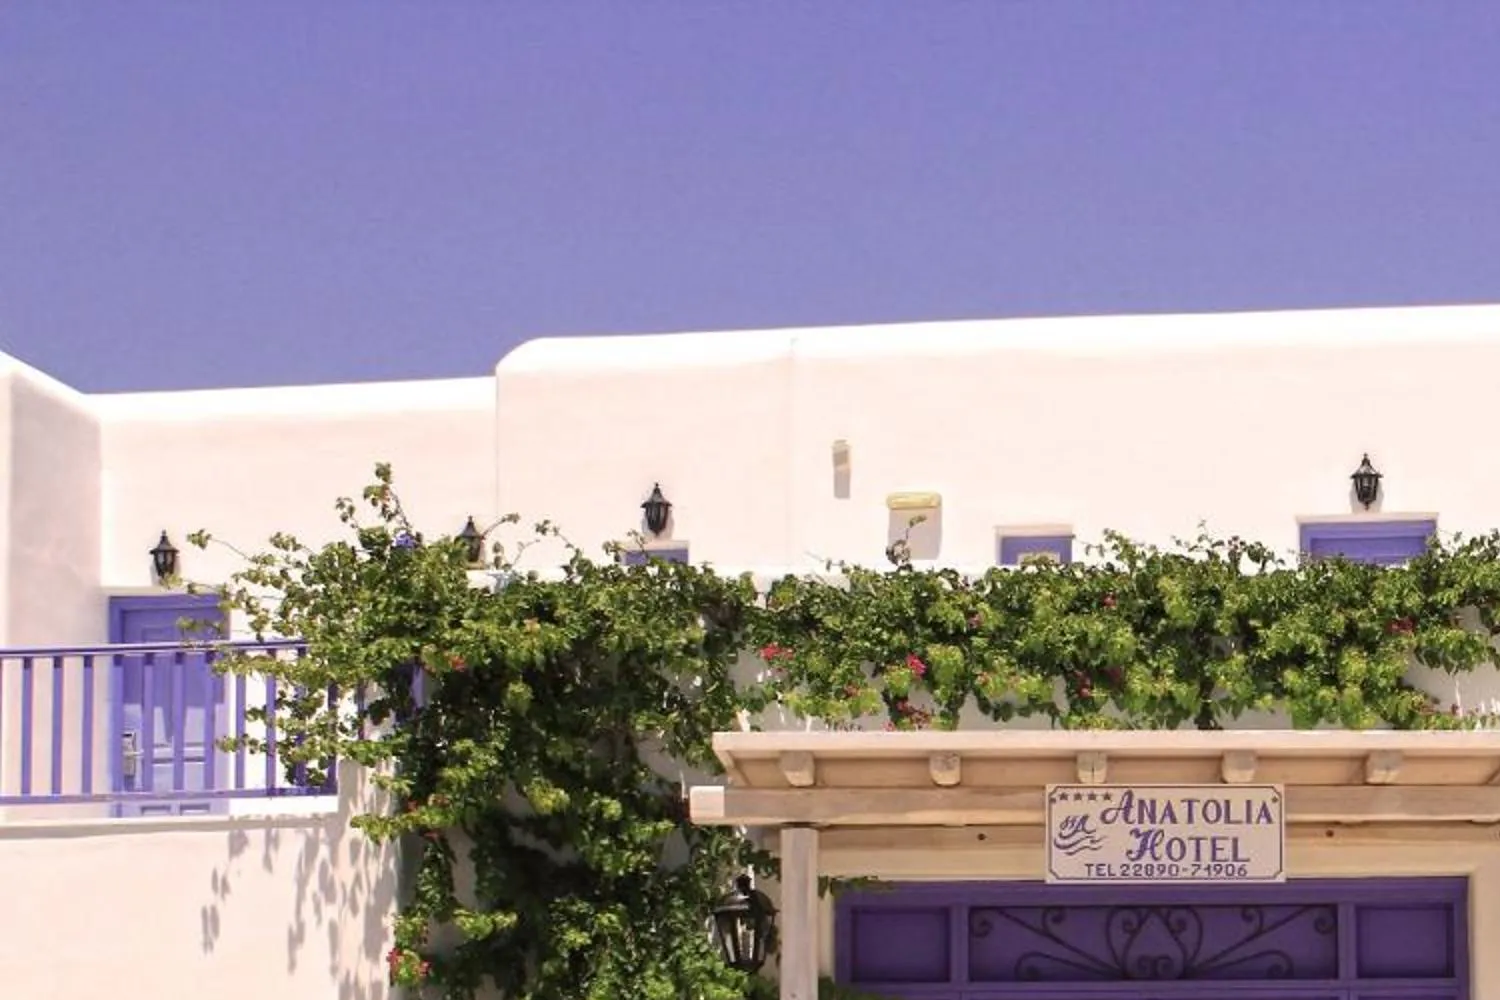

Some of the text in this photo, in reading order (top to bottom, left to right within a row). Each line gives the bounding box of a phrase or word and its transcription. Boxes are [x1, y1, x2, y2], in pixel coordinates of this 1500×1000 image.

[1100, 789, 1273, 824] ANATOLIA
[1126, 828, 1250, 862] HOTEL
[1085, 863, 1116, 877] TEL
